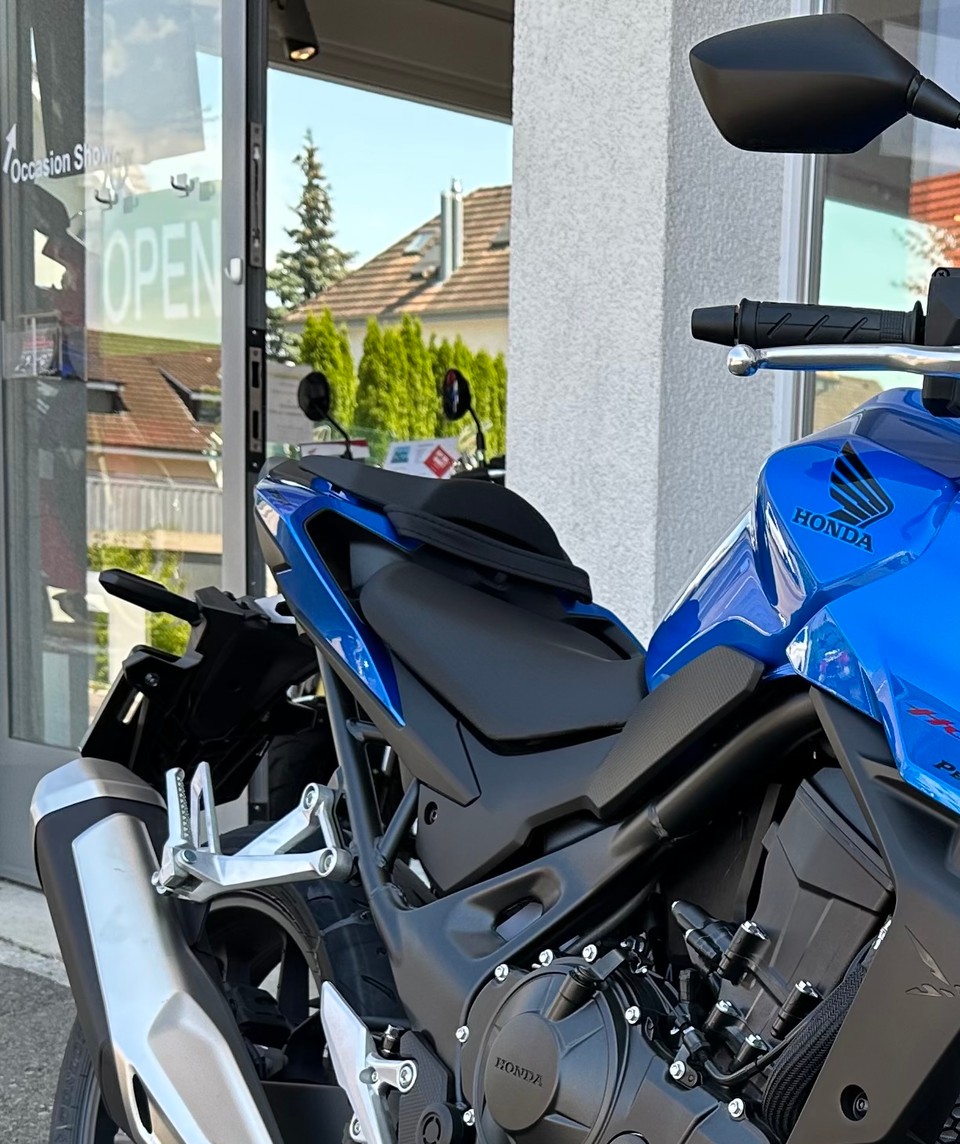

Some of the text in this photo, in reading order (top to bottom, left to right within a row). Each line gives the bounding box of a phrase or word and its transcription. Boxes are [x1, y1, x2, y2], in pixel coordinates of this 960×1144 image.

[11, 151, 70, 184] Occasion
[103, 219, 221, 324] OPEN
[791, 507, 873, 552] HONDA
[494, 1056, 544, 1088] HONDA
